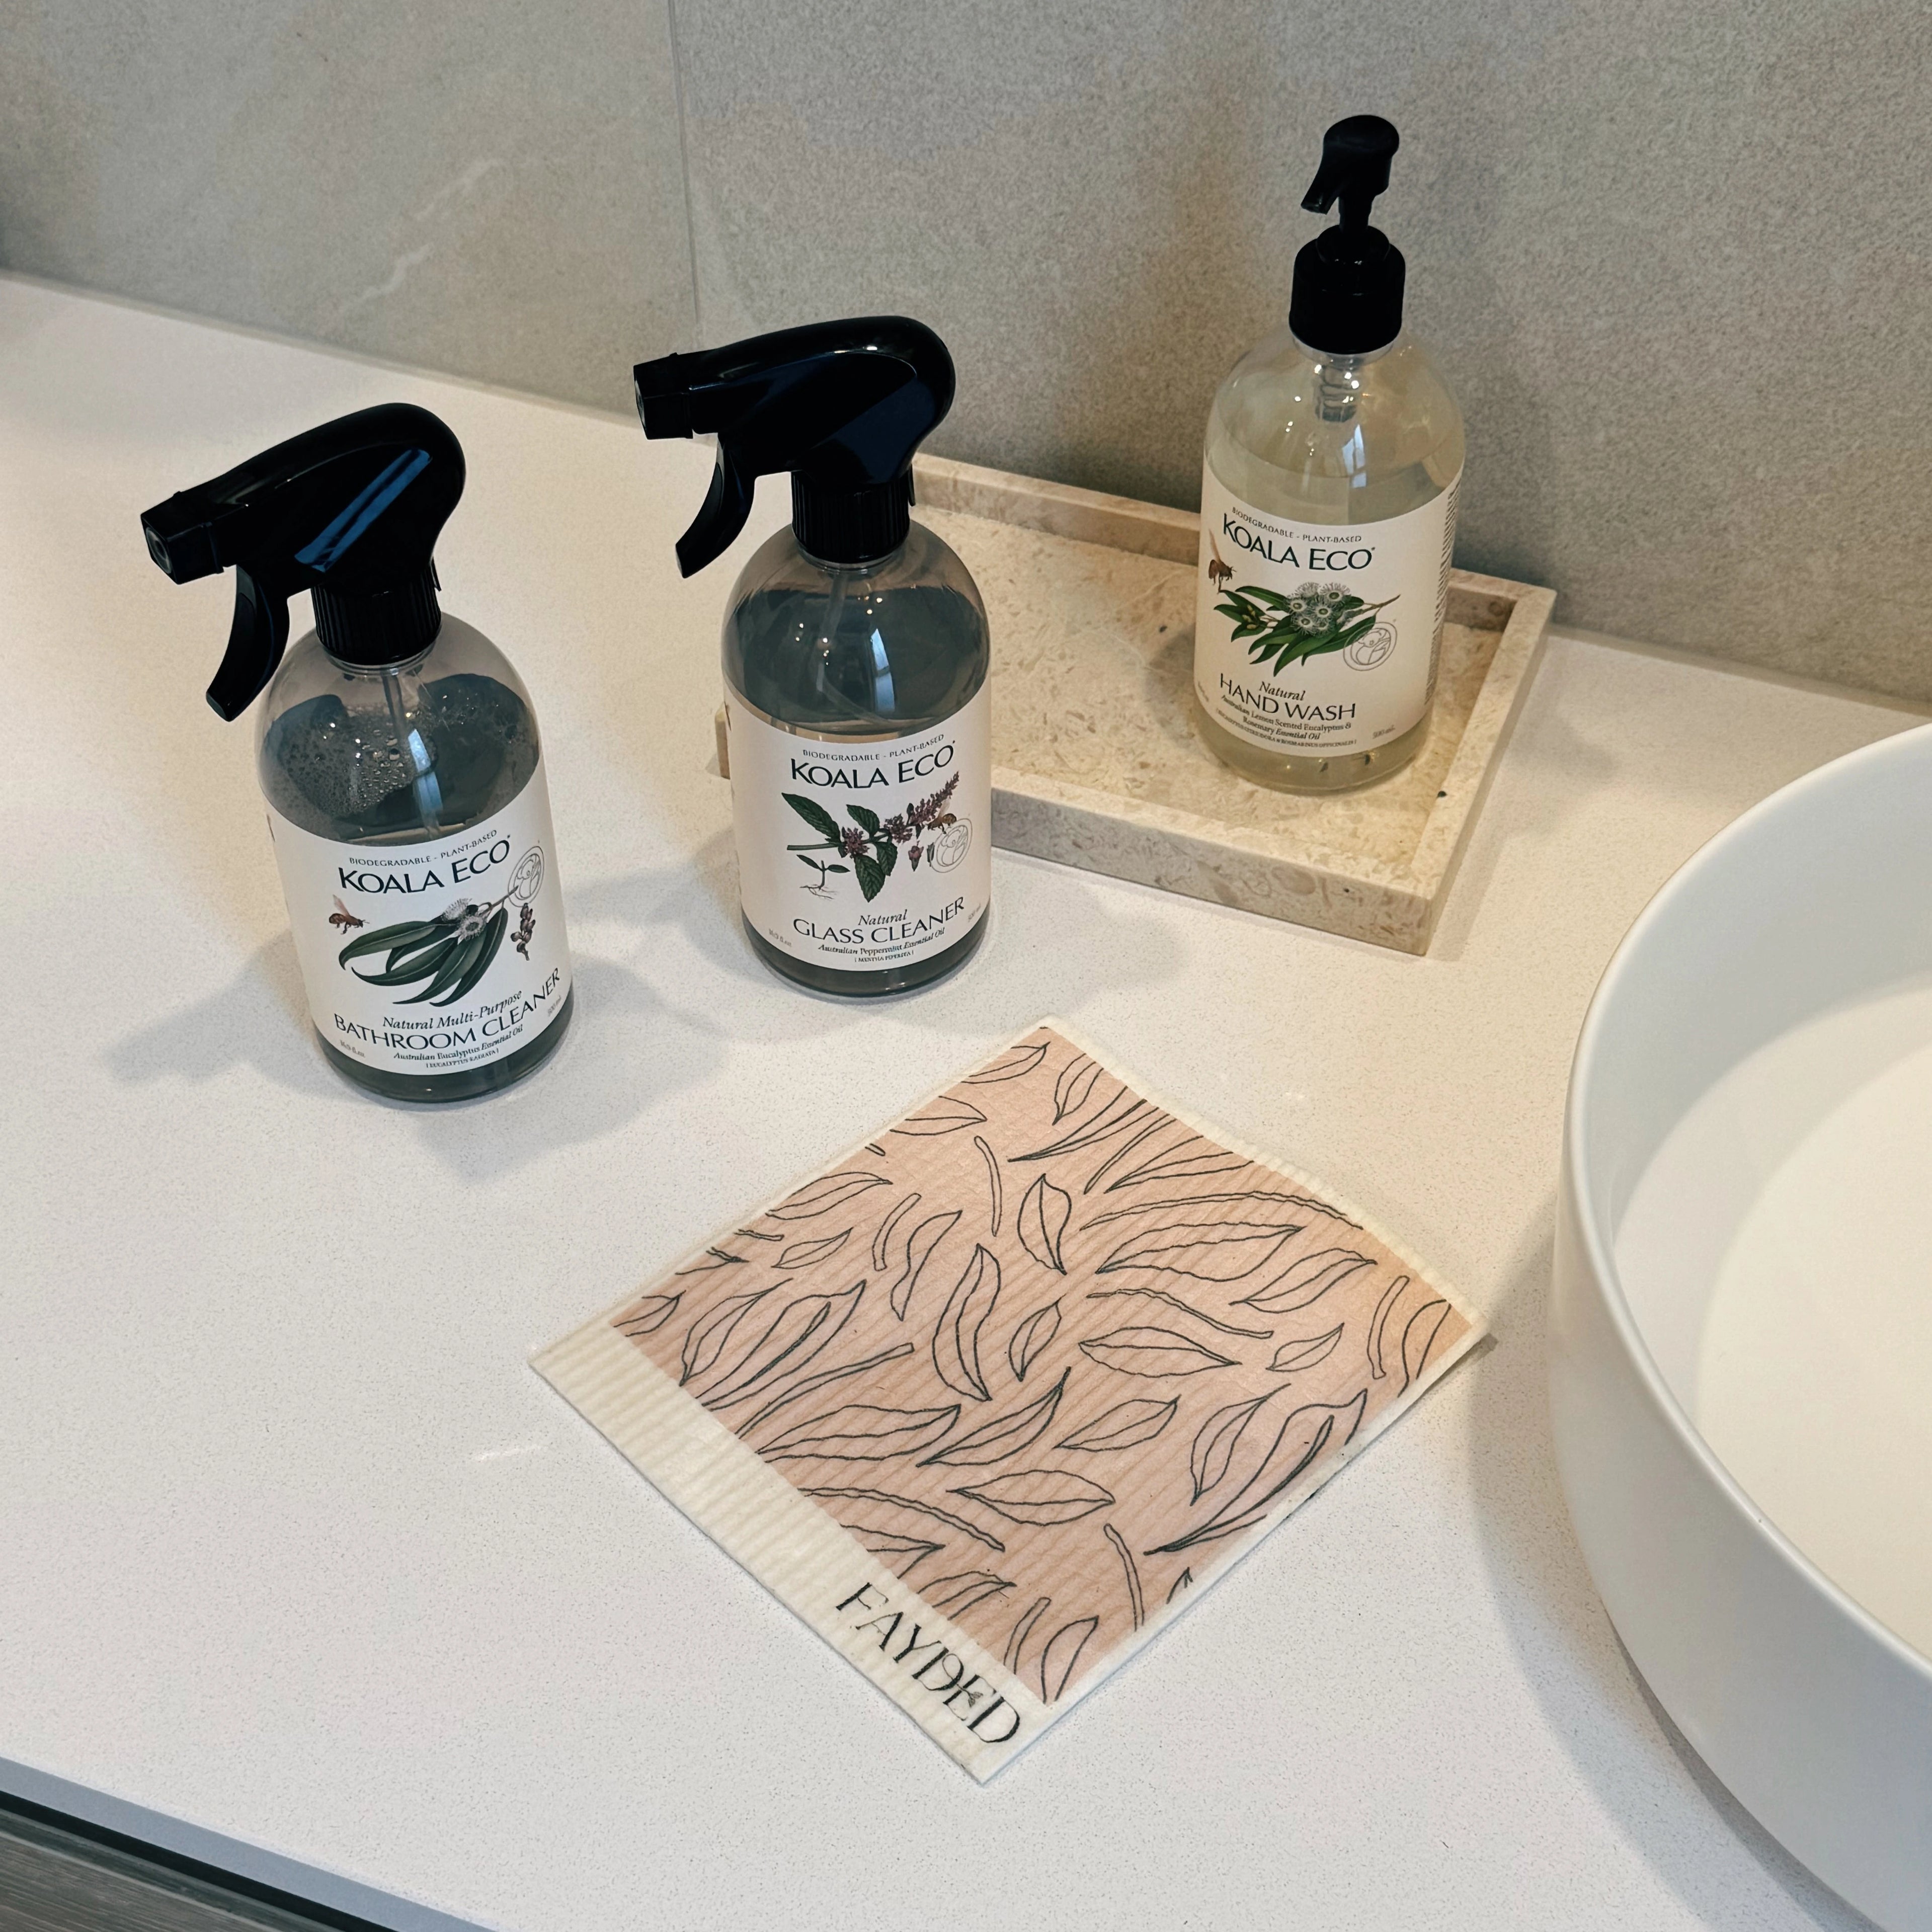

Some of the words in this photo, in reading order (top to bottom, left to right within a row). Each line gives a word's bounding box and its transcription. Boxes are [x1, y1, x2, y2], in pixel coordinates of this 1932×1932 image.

[1223, 513, 1300, 568] KOALA
[1232, 507, 1294, 538] BIODEGRADABLE
[1303, 534, 1361, 543] PLANT-BASED
[1221, 673, 1279, 713] HAND
[1284, 702, 1355, 721] WASH
[1259, 681, 1306, 701] Natural
[1251, 710, 1274, 725] Lemon
[1275, 719, 1302, 730] Scented
[1304, 724, 1343, 733] Eucalyptus
[1276, 728, 1307, 739] Essential
[803, 749, 879, 761] BIODEGRADABLE
[890, 734, 944, 758] PLANT-BASED
[791, 758, 890, 789] KOALA
[349, 856, 432, 867] BIODEGRADABLE
[441, 830, 497, 859] PLANT-BASED
[338, 867, 445, 894] KOALA
[793, 919, 864, 944] GLASS
[871, 897, 964, 943] CLEANER
[858, 909, 908, 926] Natural
[818, 944, 858, 954] Australian
[860, 944, 902, 956] Peppermint
[904, 933, 933, 949] Essential
[935, 927, 945, 937] Oil
[334, 1013, 476, 1050] BATHROOM
[482, 968, 560, 1036] CLEANER
[382, 1016, 433, 1029] Natural
[437, 990, 522, 1028] Multi-Purpose
[393, 1052, 435, 1061] Australian
[437, 1046, 480, 1059] Eucalyptus
[481, 1031, 512, 1051] Essential
[513, 1024, 523, 1035] Oil
[836, 1582, 1020, 1743] FAYDED
